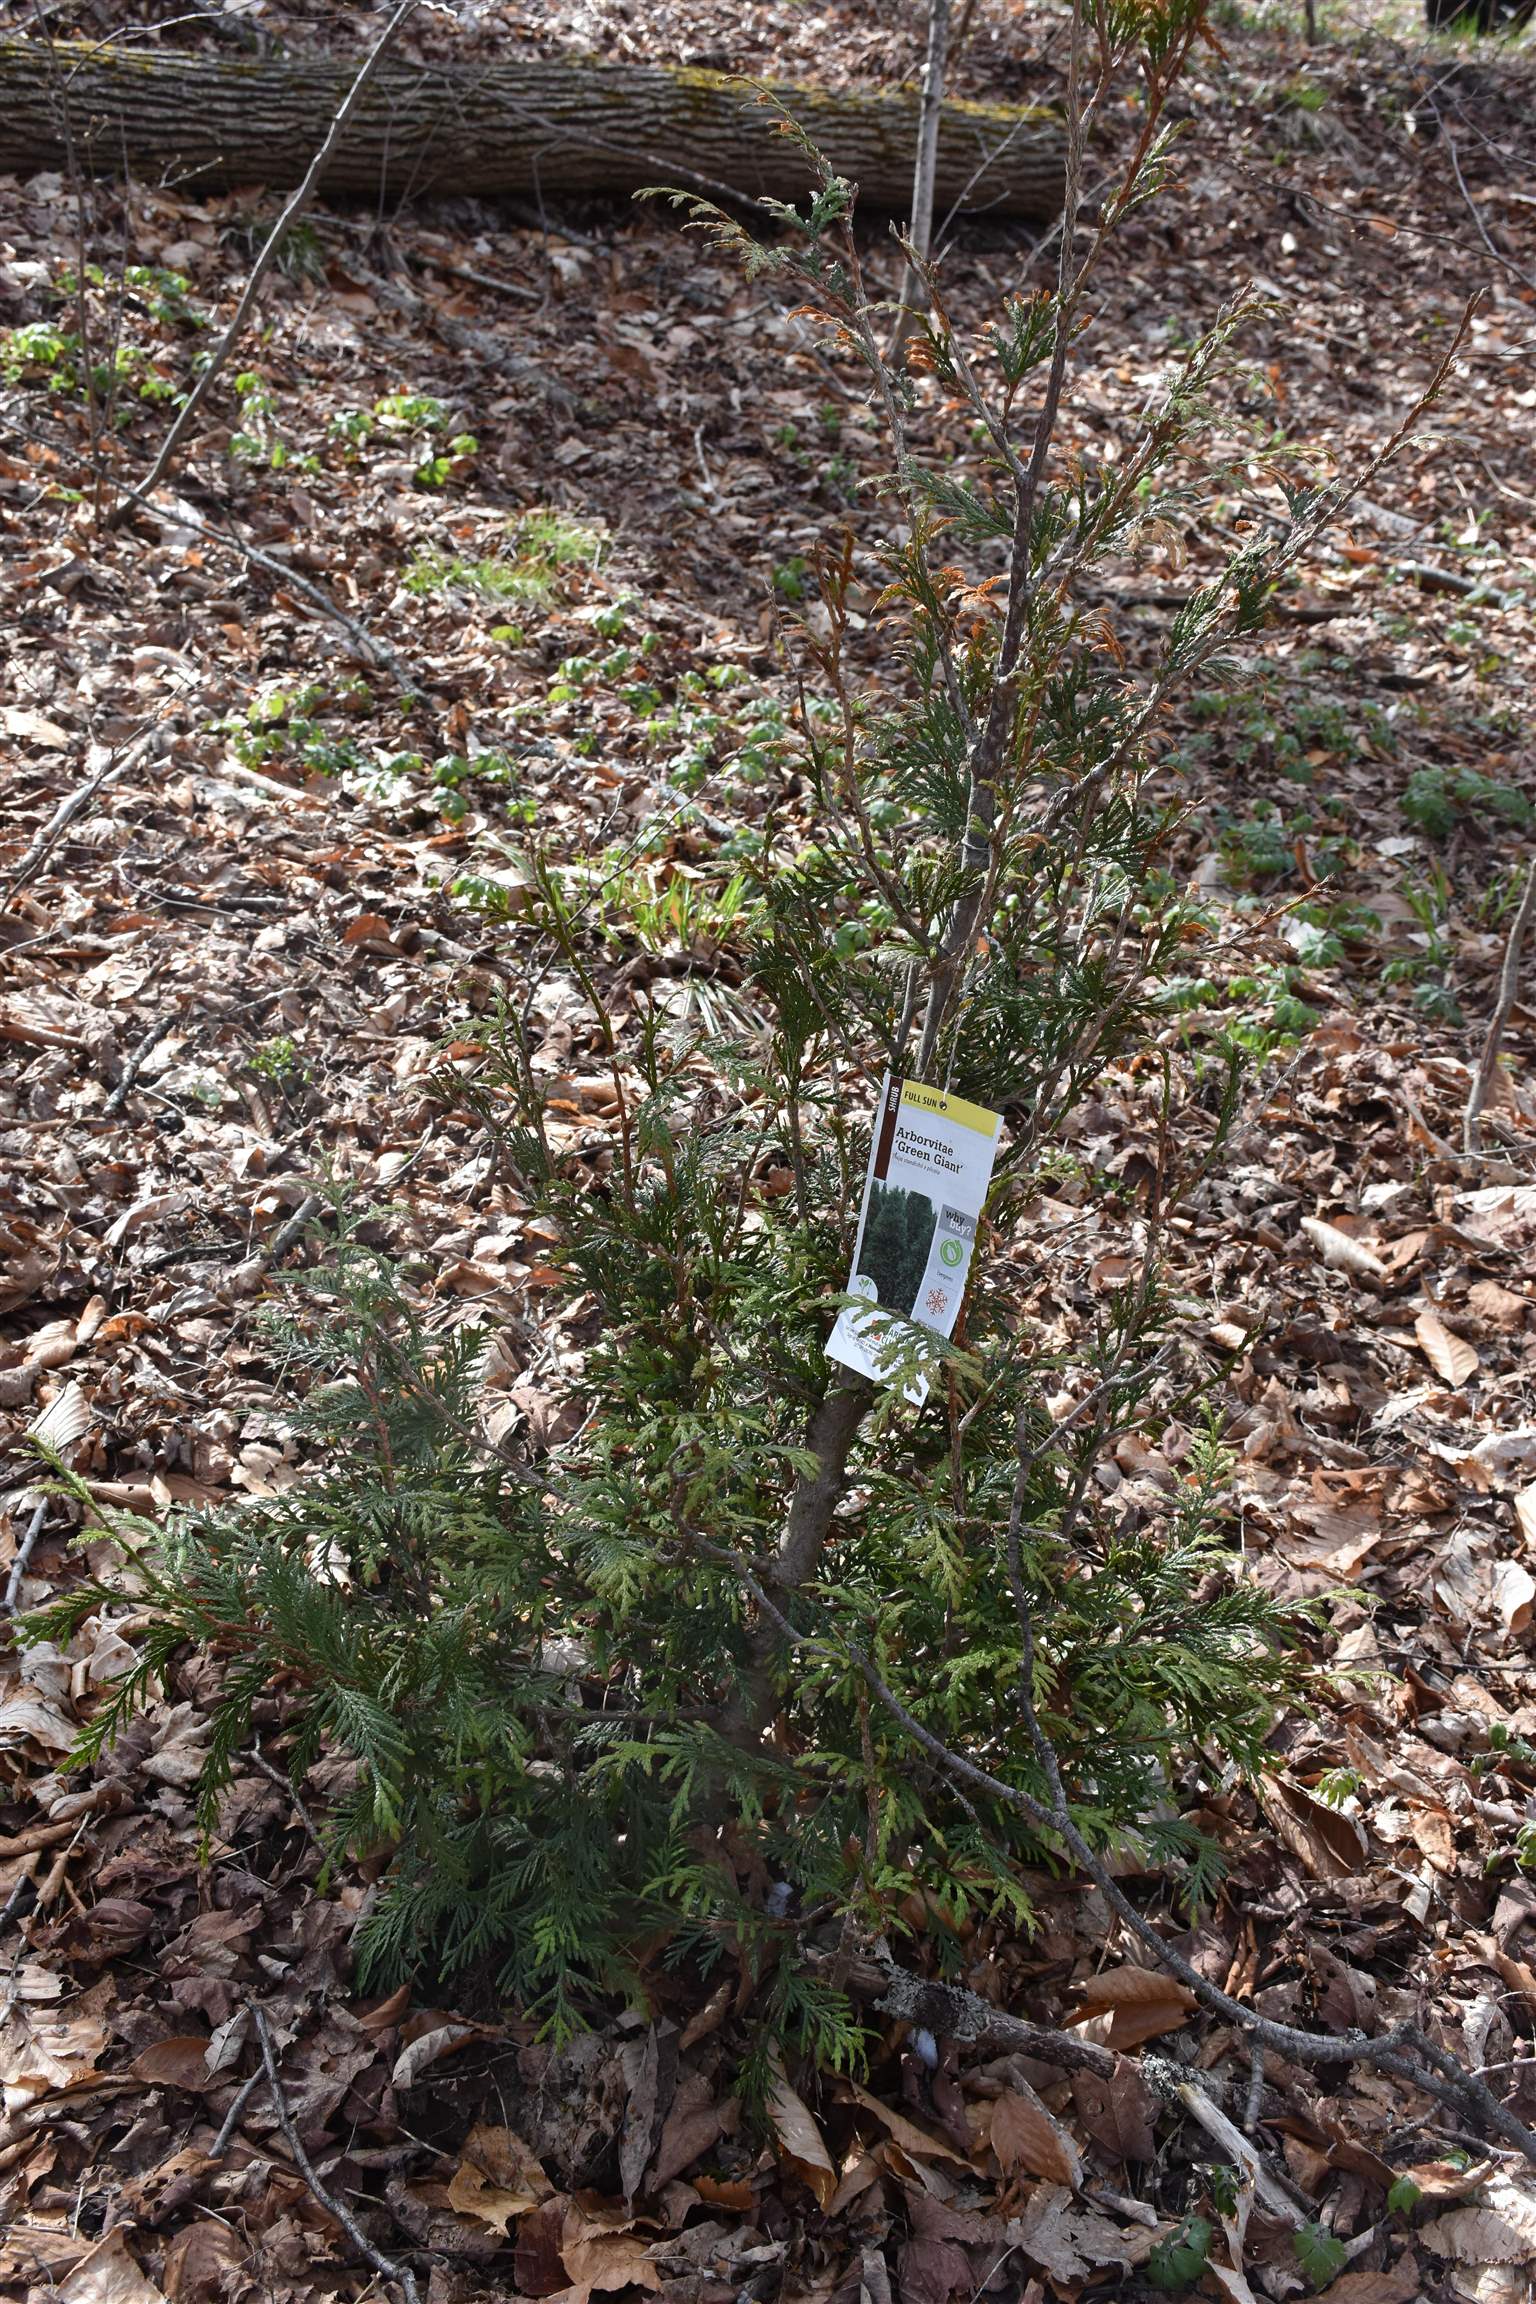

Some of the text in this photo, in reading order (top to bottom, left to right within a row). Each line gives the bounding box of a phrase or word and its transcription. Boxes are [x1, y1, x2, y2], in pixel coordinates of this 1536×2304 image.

[888, 1086, 900, 1113] SHRUB
[904, 1090, 938, 1108] FULL SUN
[896, 1127, 954, 1157] Arborvitae
[945, 1209, 966, 1227] why
[949, 1219, 972, 1236] buy?
